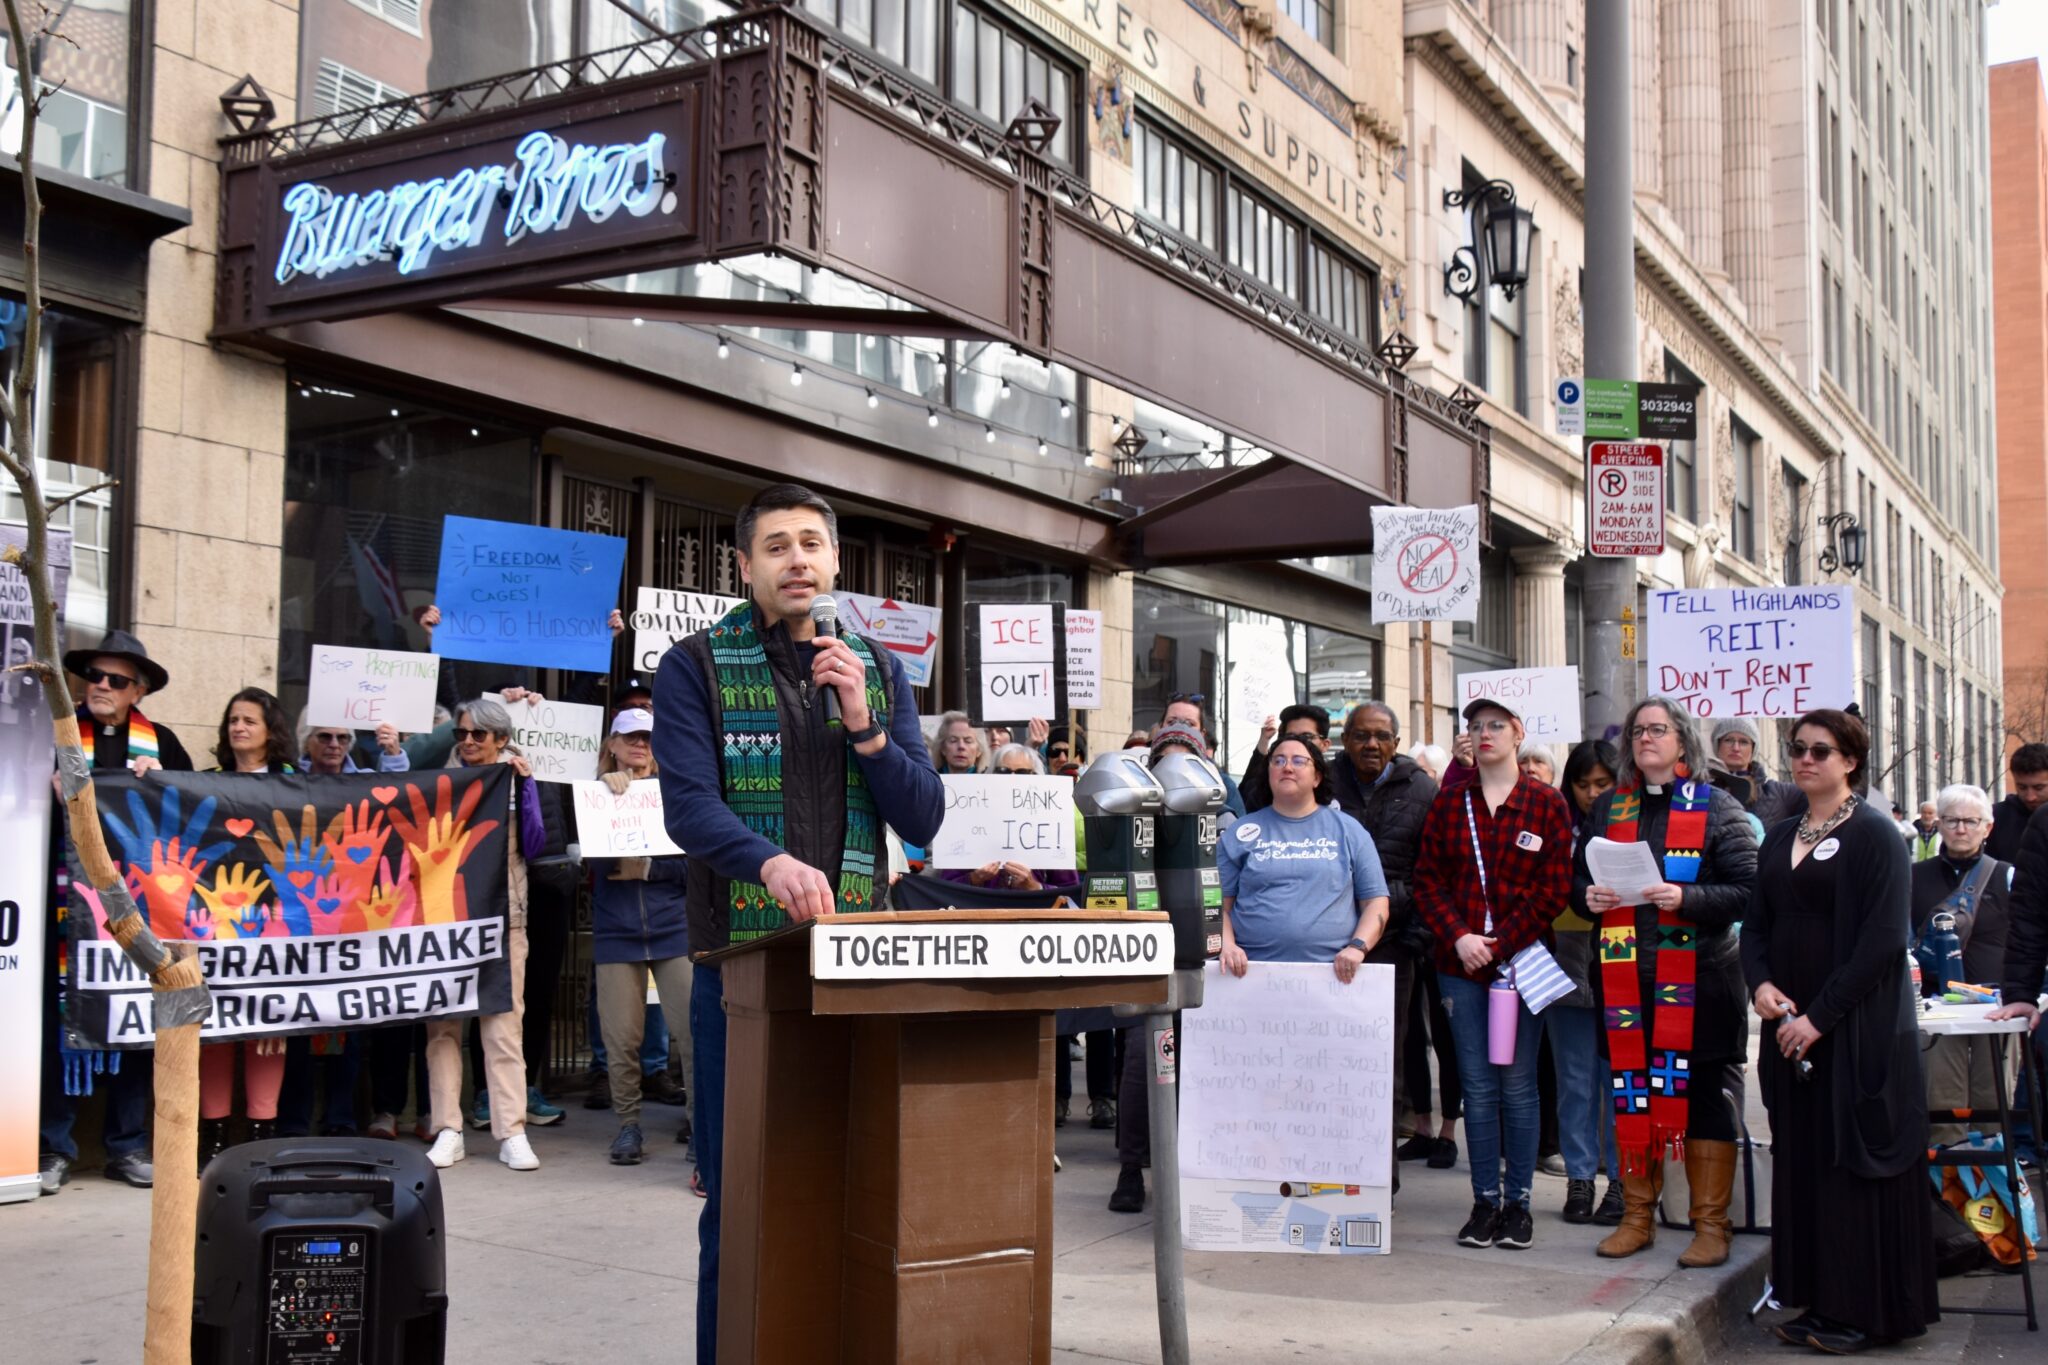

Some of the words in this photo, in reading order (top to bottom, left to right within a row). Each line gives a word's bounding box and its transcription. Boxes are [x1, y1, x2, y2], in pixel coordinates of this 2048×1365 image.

[1057, 0, 1158, 69] RES
[1193, 65, 1206, 108] &
[275, 165, 512, 286] Buerger
[504, 131, 678, 246] Bros.
[1641, 399, 1693, 413] 3032942
[1601, 455, 1653, 465] SWEEPING
[1607, 445, 1646, 455] STREET
[1633, 471, 1655, 481] THIS
[1633, 486, 1655, 496] SIDE
[1376, 514, 1398, 532] Tell
[1600, 516, 1642, 528] MONDAY
[1647, 518, 1654, 528] &
[1595, 531, 1660, 543] WEDNESDAY
[473, 545, 562, 568] FREEDOM
[1407, 543, 1433, 565] NO
[1596, 546, 1613, 554] TOW
[1614, 546, 1637, 554] AWAY
[1639, 546, 1660, 554] ZONE
[501, 572, 533, 584] NOT
[655, 592, 727, 615] FUND
[1656, 591, 1716, 613] TELL
[1732, 590, 1841, 612] HIGHLANDS
[451, 611, 486, 636] NO
[990, 618, 1043, 645] ICE
[1079, 616, 1094, 626] Thy
[1700, 619, 1796, 652] REIT:
[320, 654, 353, 674] STOP
[366, 651, 438, 678] PROFITING
[1659, 662, 1732, 692] DON'T
[1746, 658, 1813, 687] RENT
[990, 669, 1048, 698] OUT!
[1087, 679, 1095, 687] in
[1468, 674, 1544, 699] DIVEST
[344, 698, 387, 721] ICE
[525, 704, 556, 728] NO
[584, 790, 606, 810] NO
[1012, 788, 1063, 810] BANK
[971, 825, 988, 836] on
[1001, 820, 1061, 850] ICE!
[1135, 819, 1143, 845] 2
[1200, 817, 1207, 843] 2
[1255, 838, 1315, 851] Immigrants
[1272, 849, 1321, 859] Essential
[86, 938, 361, 983] IMGRANTS
[379, 923, 501, 967] MAKE
[829, 934, 989, 967] TOGETHER
[1020, 933, 1158, 965] COLORADO
[117, 993, 319, 1036] ARICA
[339, 975, 475, 1021] GREAT
